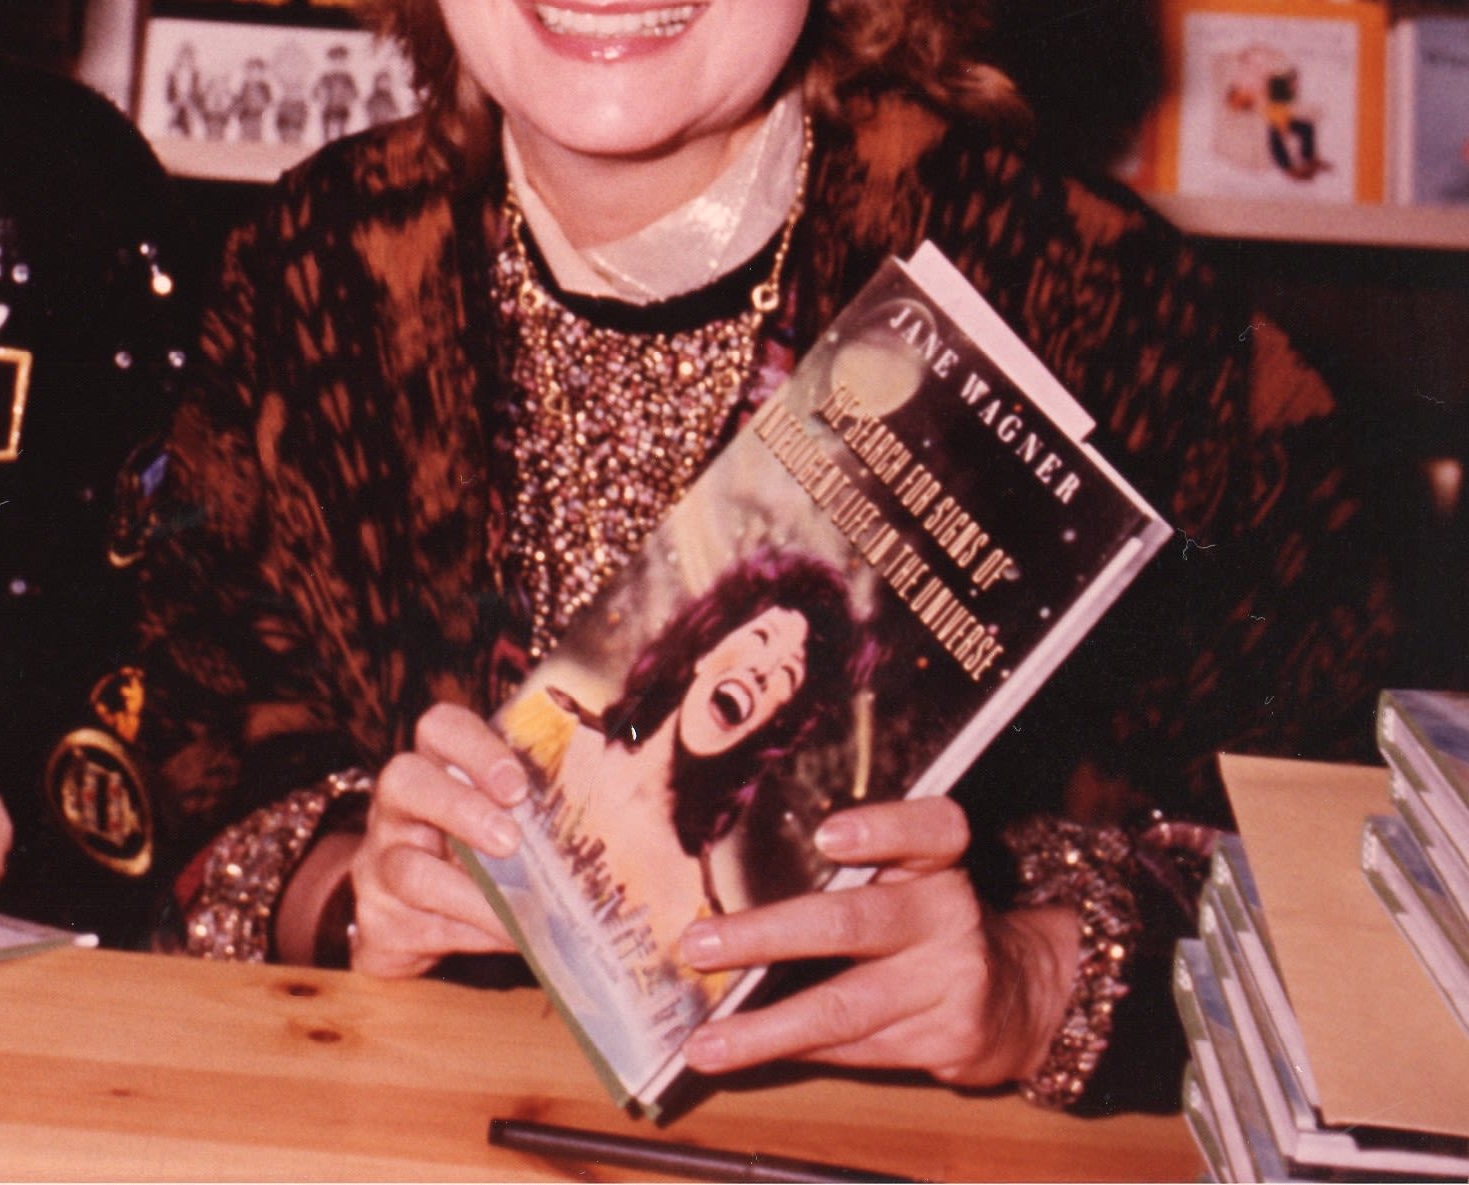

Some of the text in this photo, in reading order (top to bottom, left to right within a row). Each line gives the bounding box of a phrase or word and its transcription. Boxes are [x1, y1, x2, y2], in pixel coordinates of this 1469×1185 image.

[843, 413, 913, 485] SEARCH
[894, 463, 942, 517] FOR
[922, 495, 991, 569] SIGNS
[970, 547, 1014, 592] OF
[889, 307, 1083, 506] JANE WAGNER
[753, 402, 1005, 683] INTELLIGENT LIFE IN THE UNIVERSE
